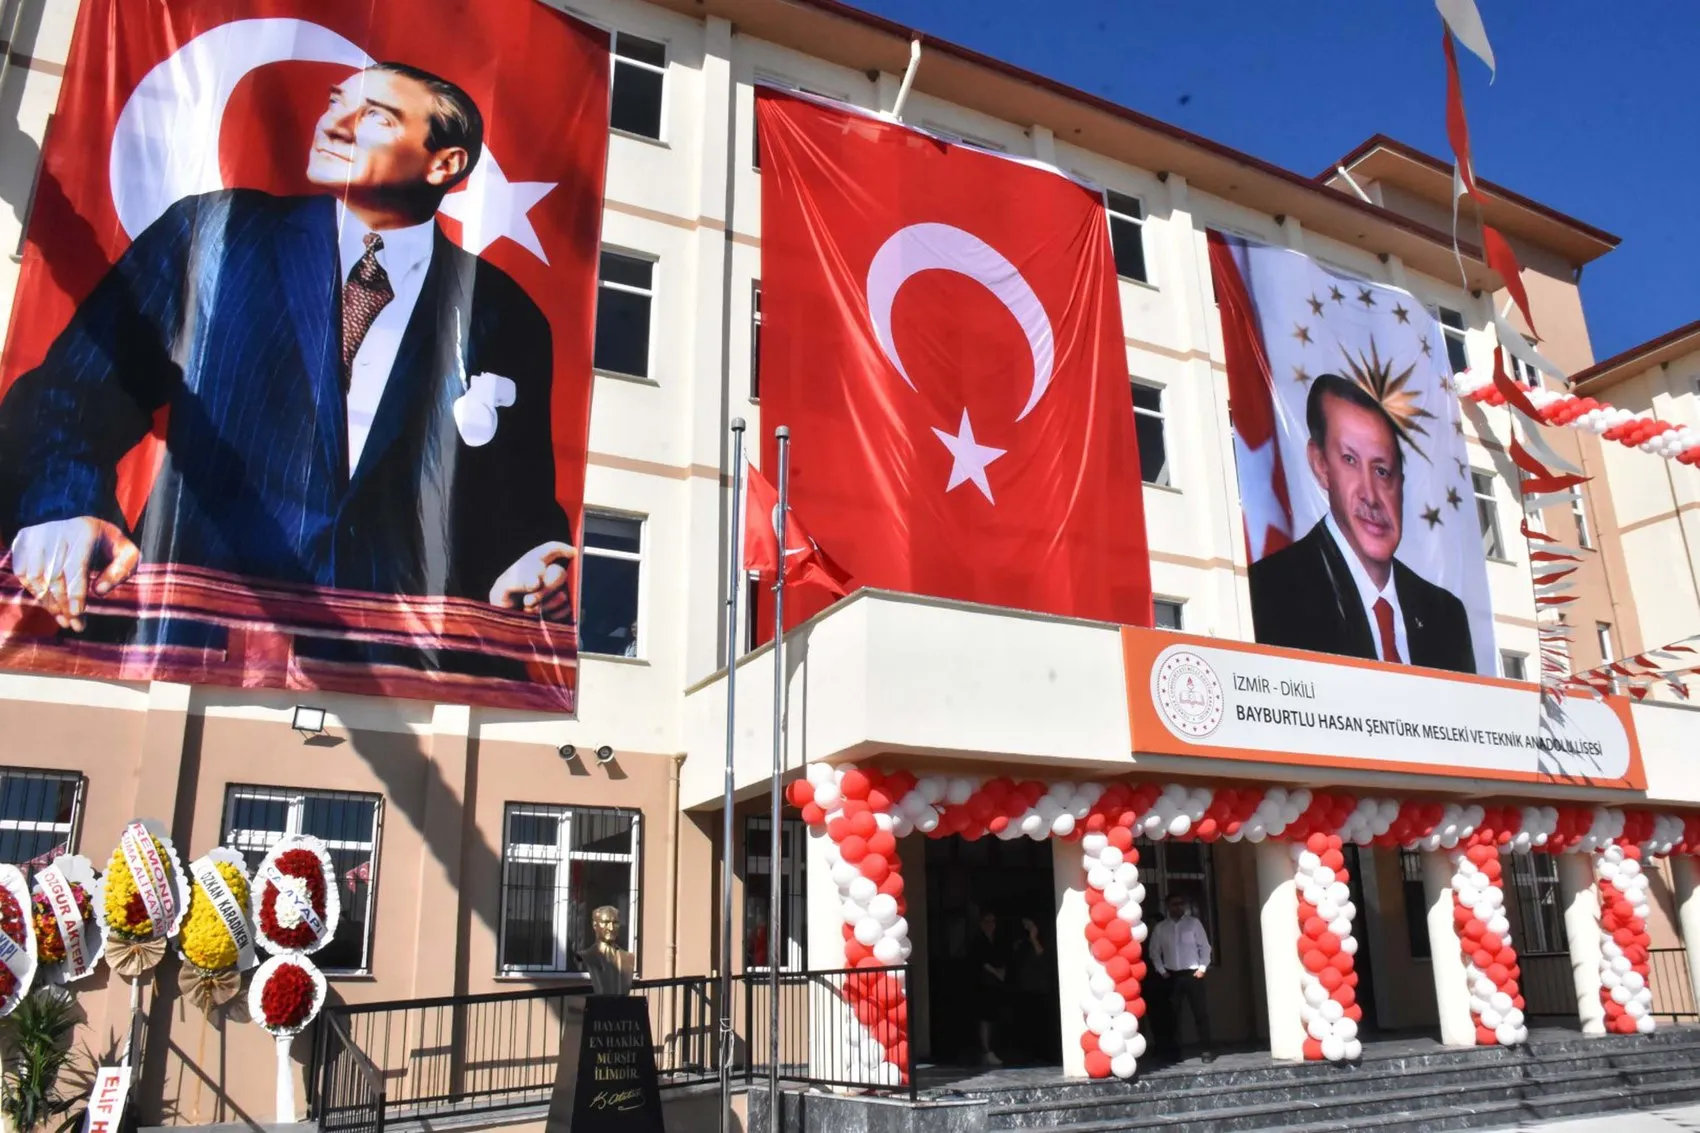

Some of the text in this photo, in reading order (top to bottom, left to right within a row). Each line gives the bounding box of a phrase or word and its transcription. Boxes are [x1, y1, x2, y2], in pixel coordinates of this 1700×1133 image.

[1232, 672, 1271, 694] İZMİR
[1281, 679, 1316, 699] DİKİLİ
[1235, 704, 1316, 728] BAYBURTLU
[1318, 713, 1364, 733] HASAN
[1365, 718, 1421, 739] ŞENTÜRK
[1422, 724, 1470, 743] MESLEKİ
[1470, 730, 1485, 745] VE
[1485, 731, 1524, 748] TEKNİK
[218, 898, 249, 950] KARADİKEN
[64, 920, 87, 976] AKTEPE
[589, 1036, 604, 1049] EN
[593, 1020, 640, 1032] HAYATTA
[97, 1076, 120, 1114] ELİF
